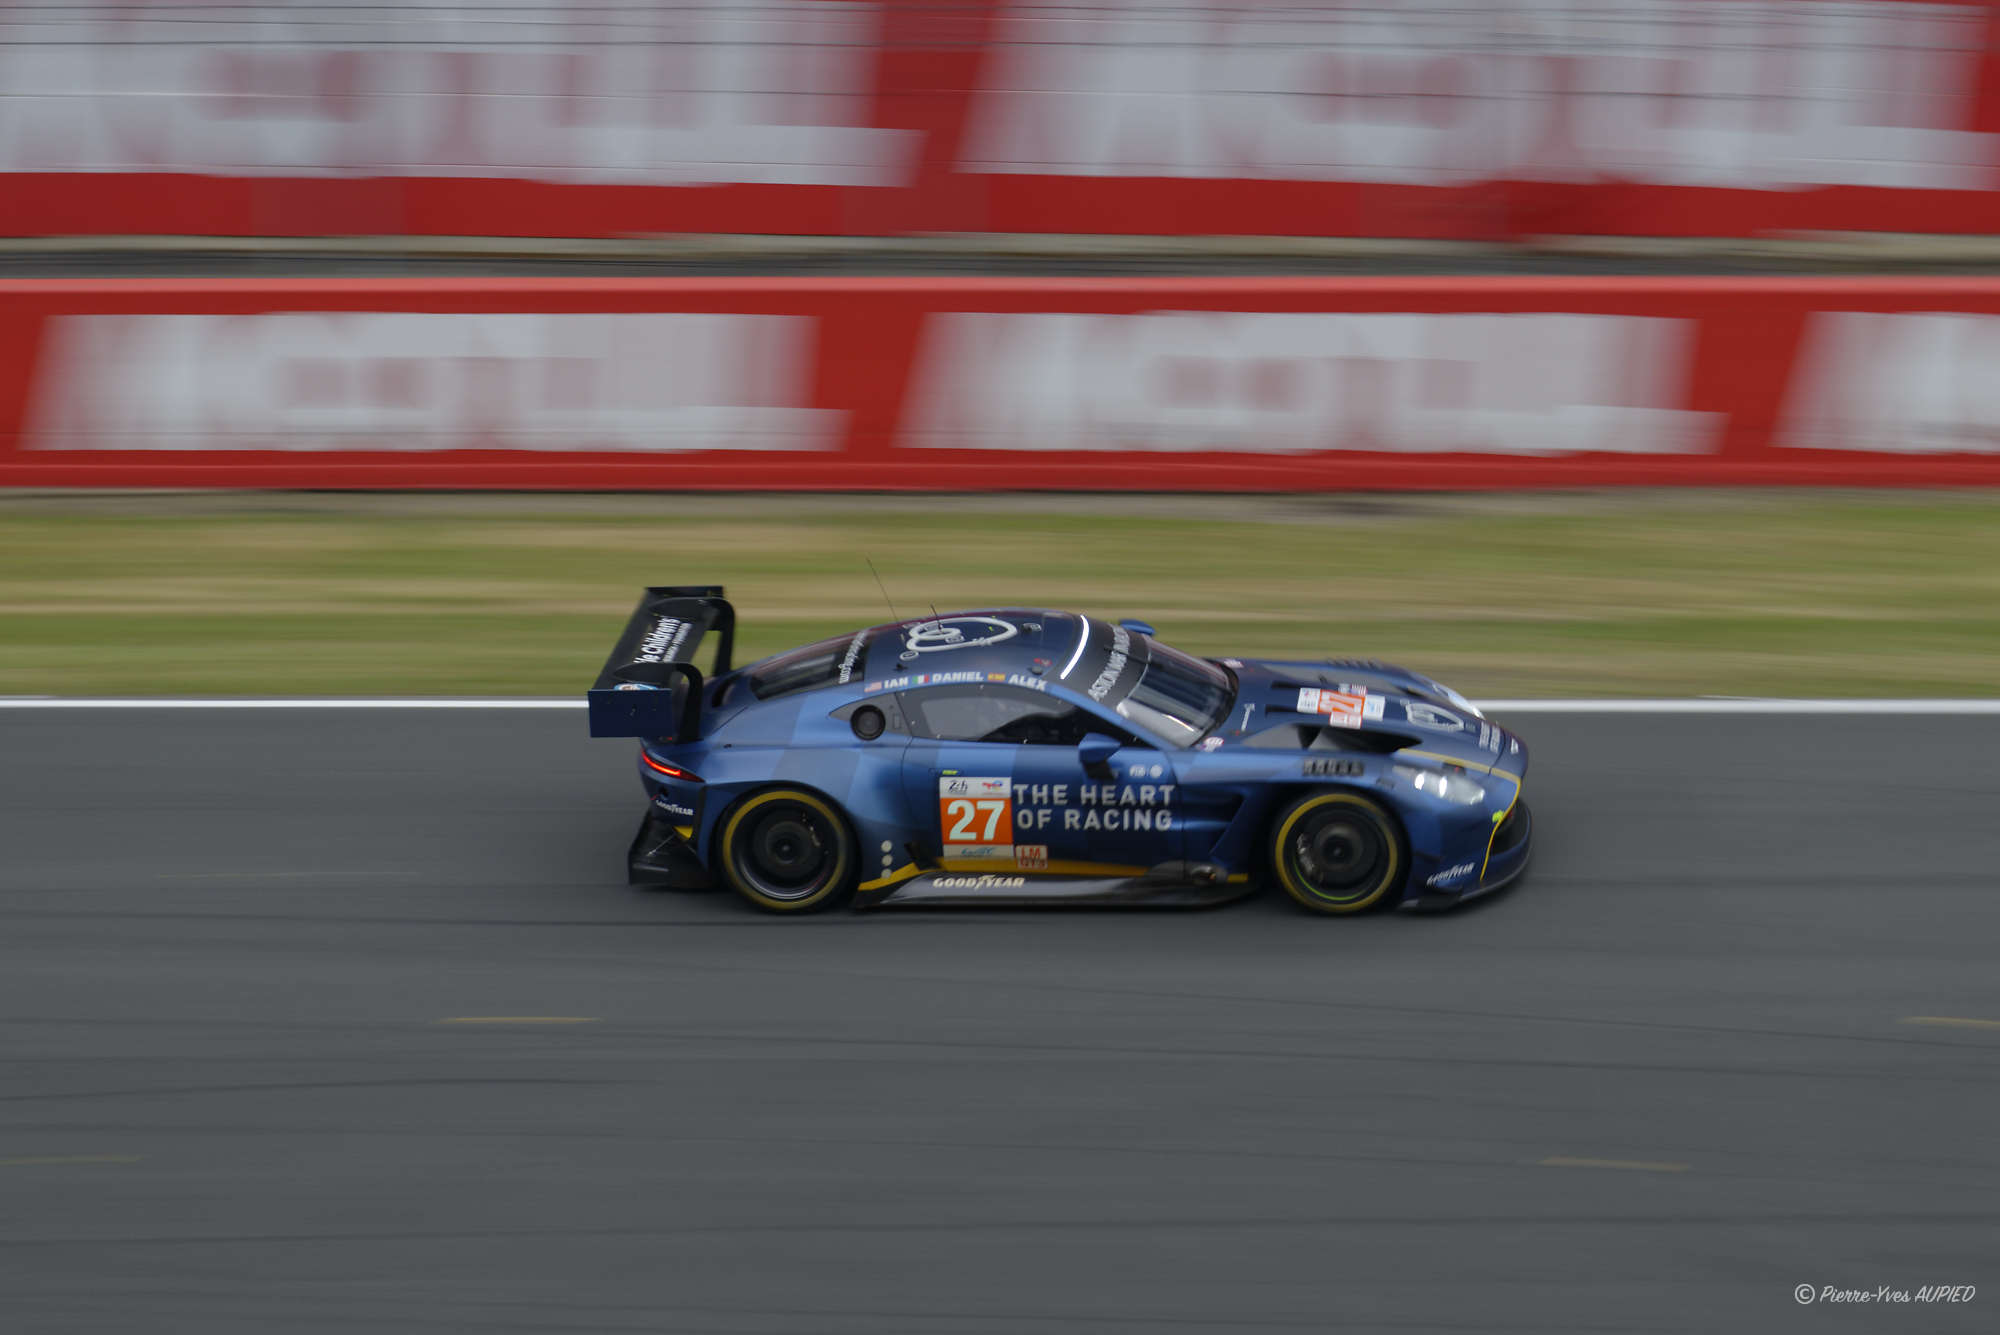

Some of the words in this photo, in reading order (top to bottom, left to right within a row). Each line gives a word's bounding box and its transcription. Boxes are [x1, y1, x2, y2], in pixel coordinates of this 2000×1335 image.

[884, 677, 908, 689] IAN
[932, 671, 984, 684] DANIEL
[1008, 674, 1048, 692] ALEX
[1013, 784, 1068, 805] THE
[1080, 784, 1175, 806] HEART
[947, 800, 1005, 841] 27
[1017, 809, 1052, 830] OF
[1064, 809, 1173, 831] RACING
[932, 874, 1026, 890] GOODYEAR
